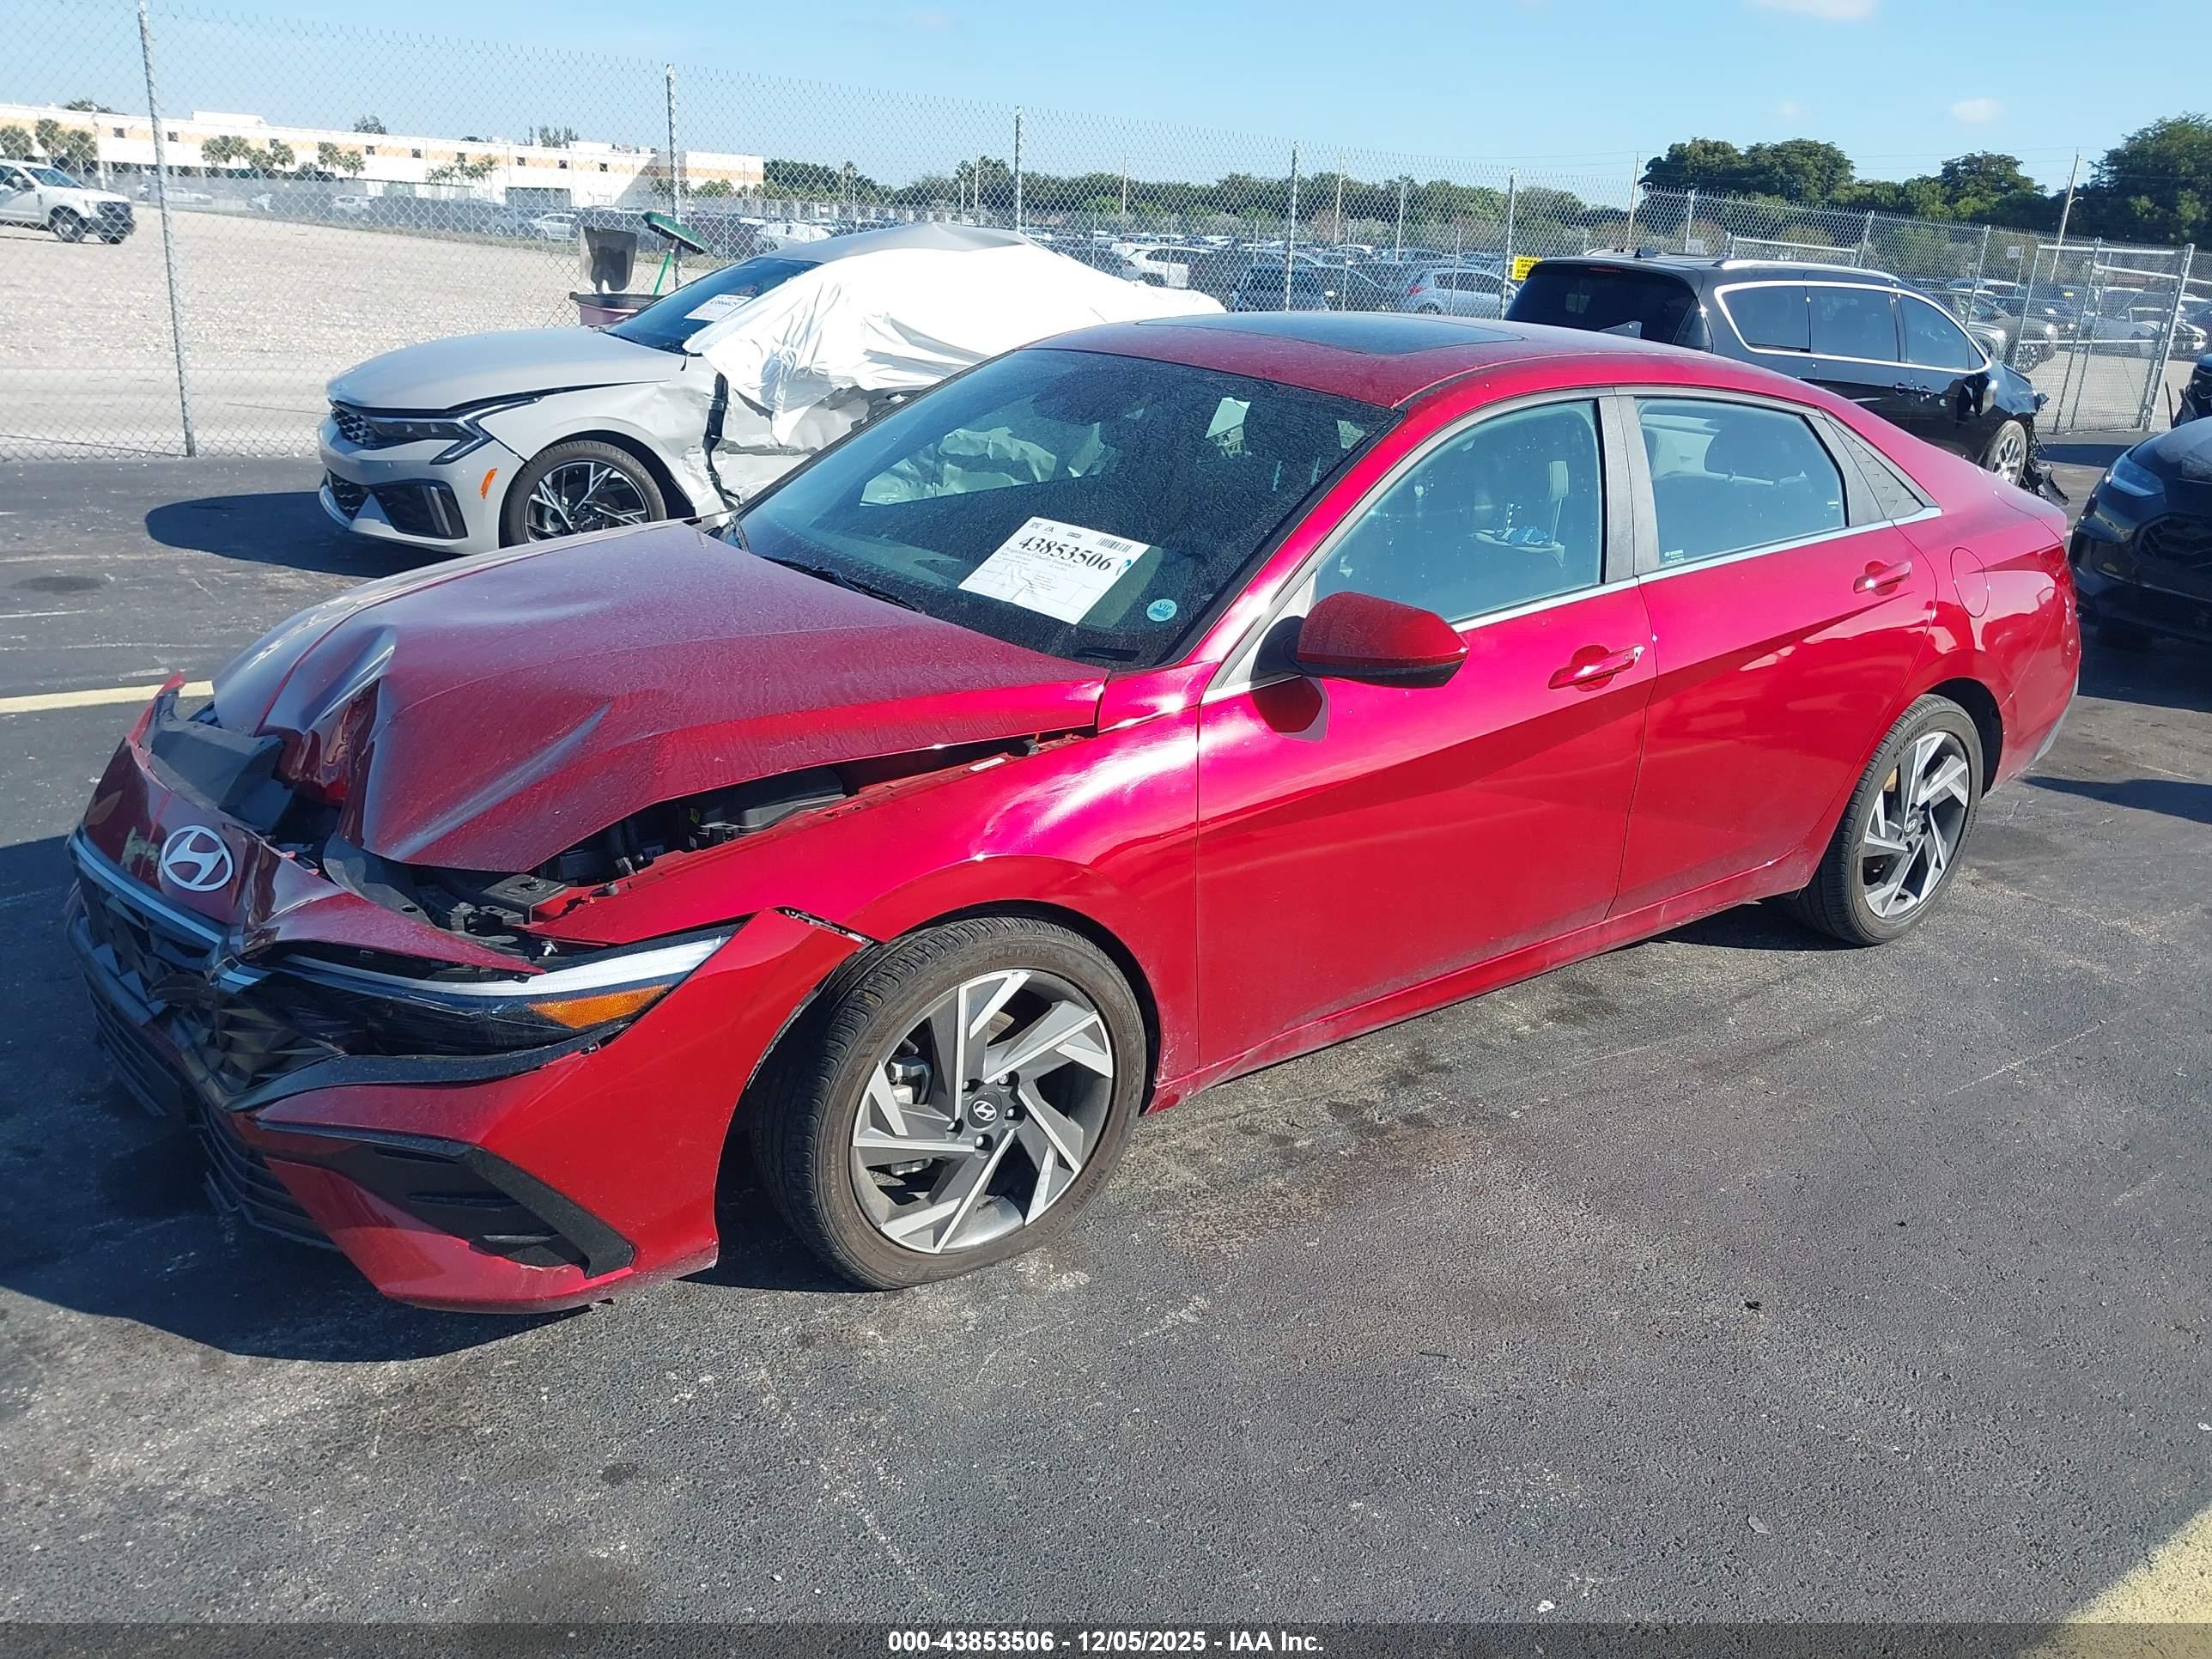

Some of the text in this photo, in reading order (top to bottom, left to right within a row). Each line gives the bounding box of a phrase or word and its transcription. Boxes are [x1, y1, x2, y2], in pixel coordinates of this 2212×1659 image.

[1018, 536, 1117, 571] 43853506
[1158, 602, 1173, 611] VIP
[1893, 721, 1928, 759] KUMHO
